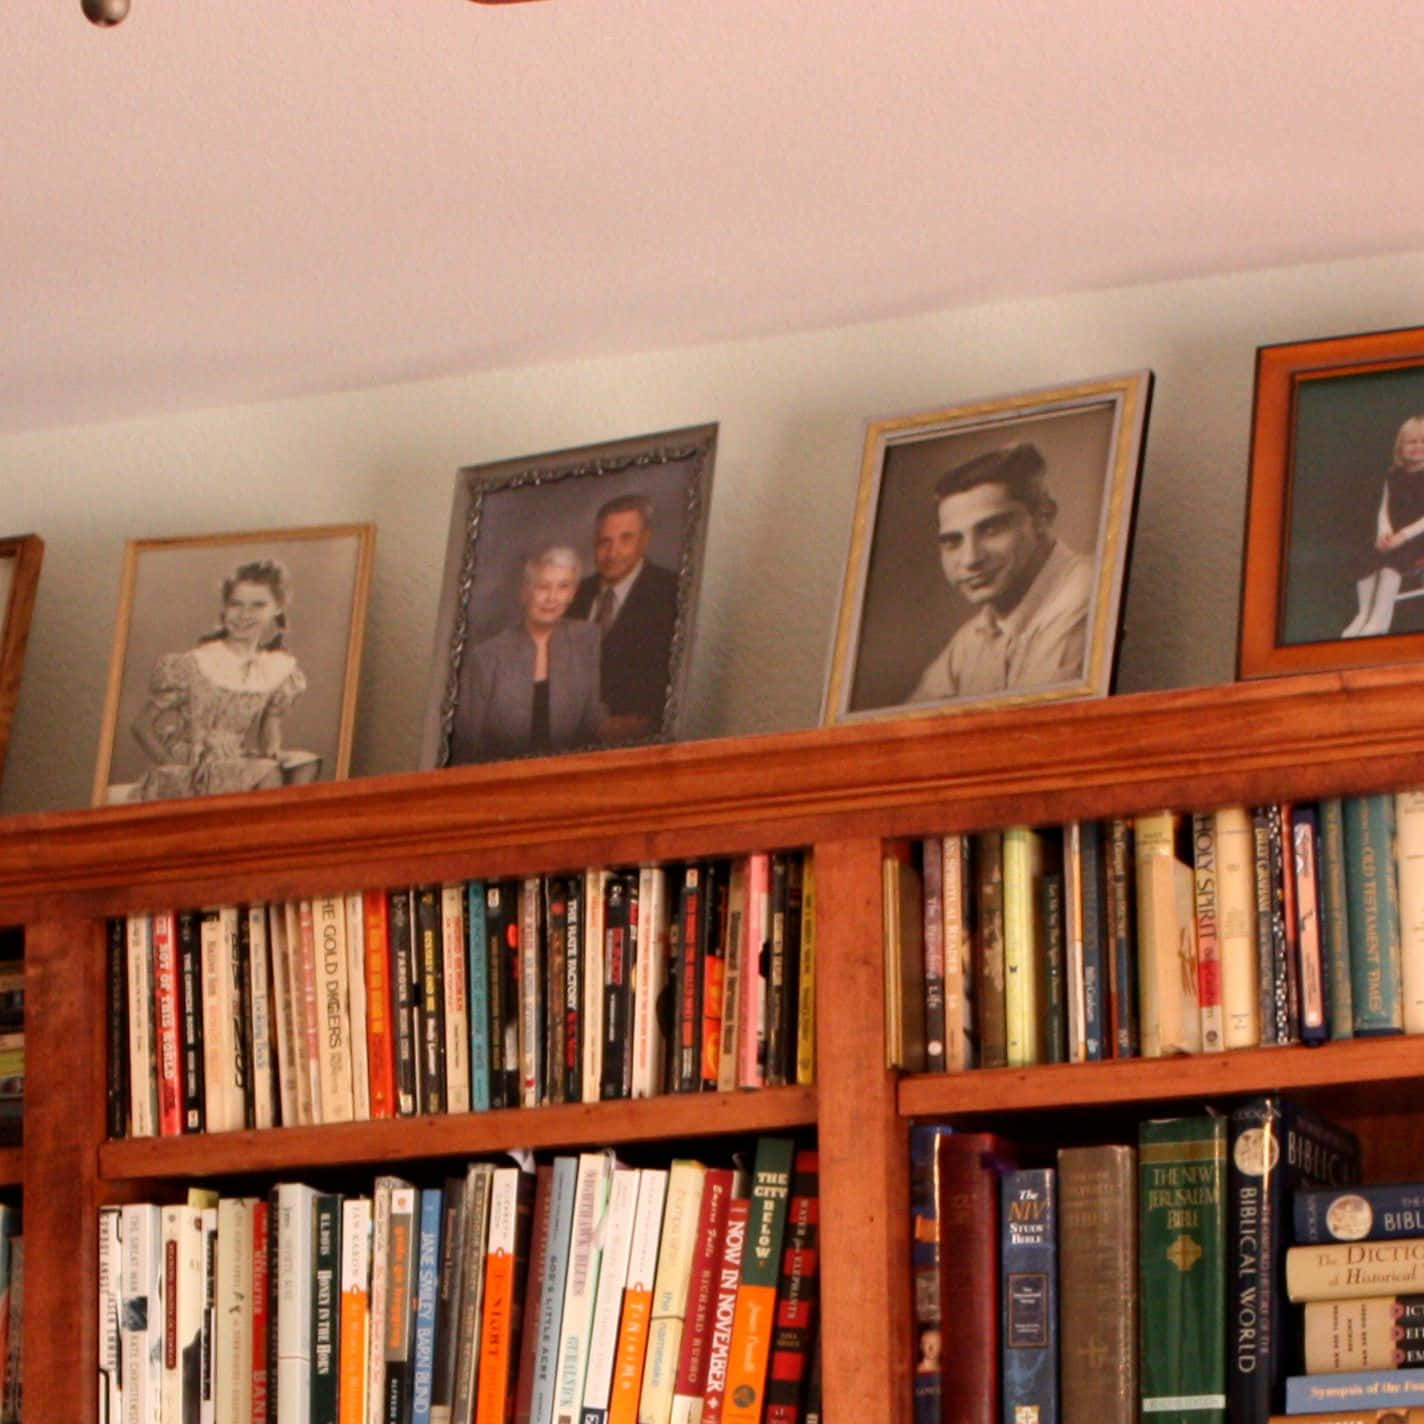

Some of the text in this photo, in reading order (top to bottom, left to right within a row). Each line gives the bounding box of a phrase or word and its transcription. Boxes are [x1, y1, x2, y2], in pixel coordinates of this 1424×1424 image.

[707, 1221, 745, 1392] NOW IN NOVEMBER
[1238, 1188, 1257, 1374] BIBLICAL WORLD
[1346, 1264, 1416, 1286] Historical
